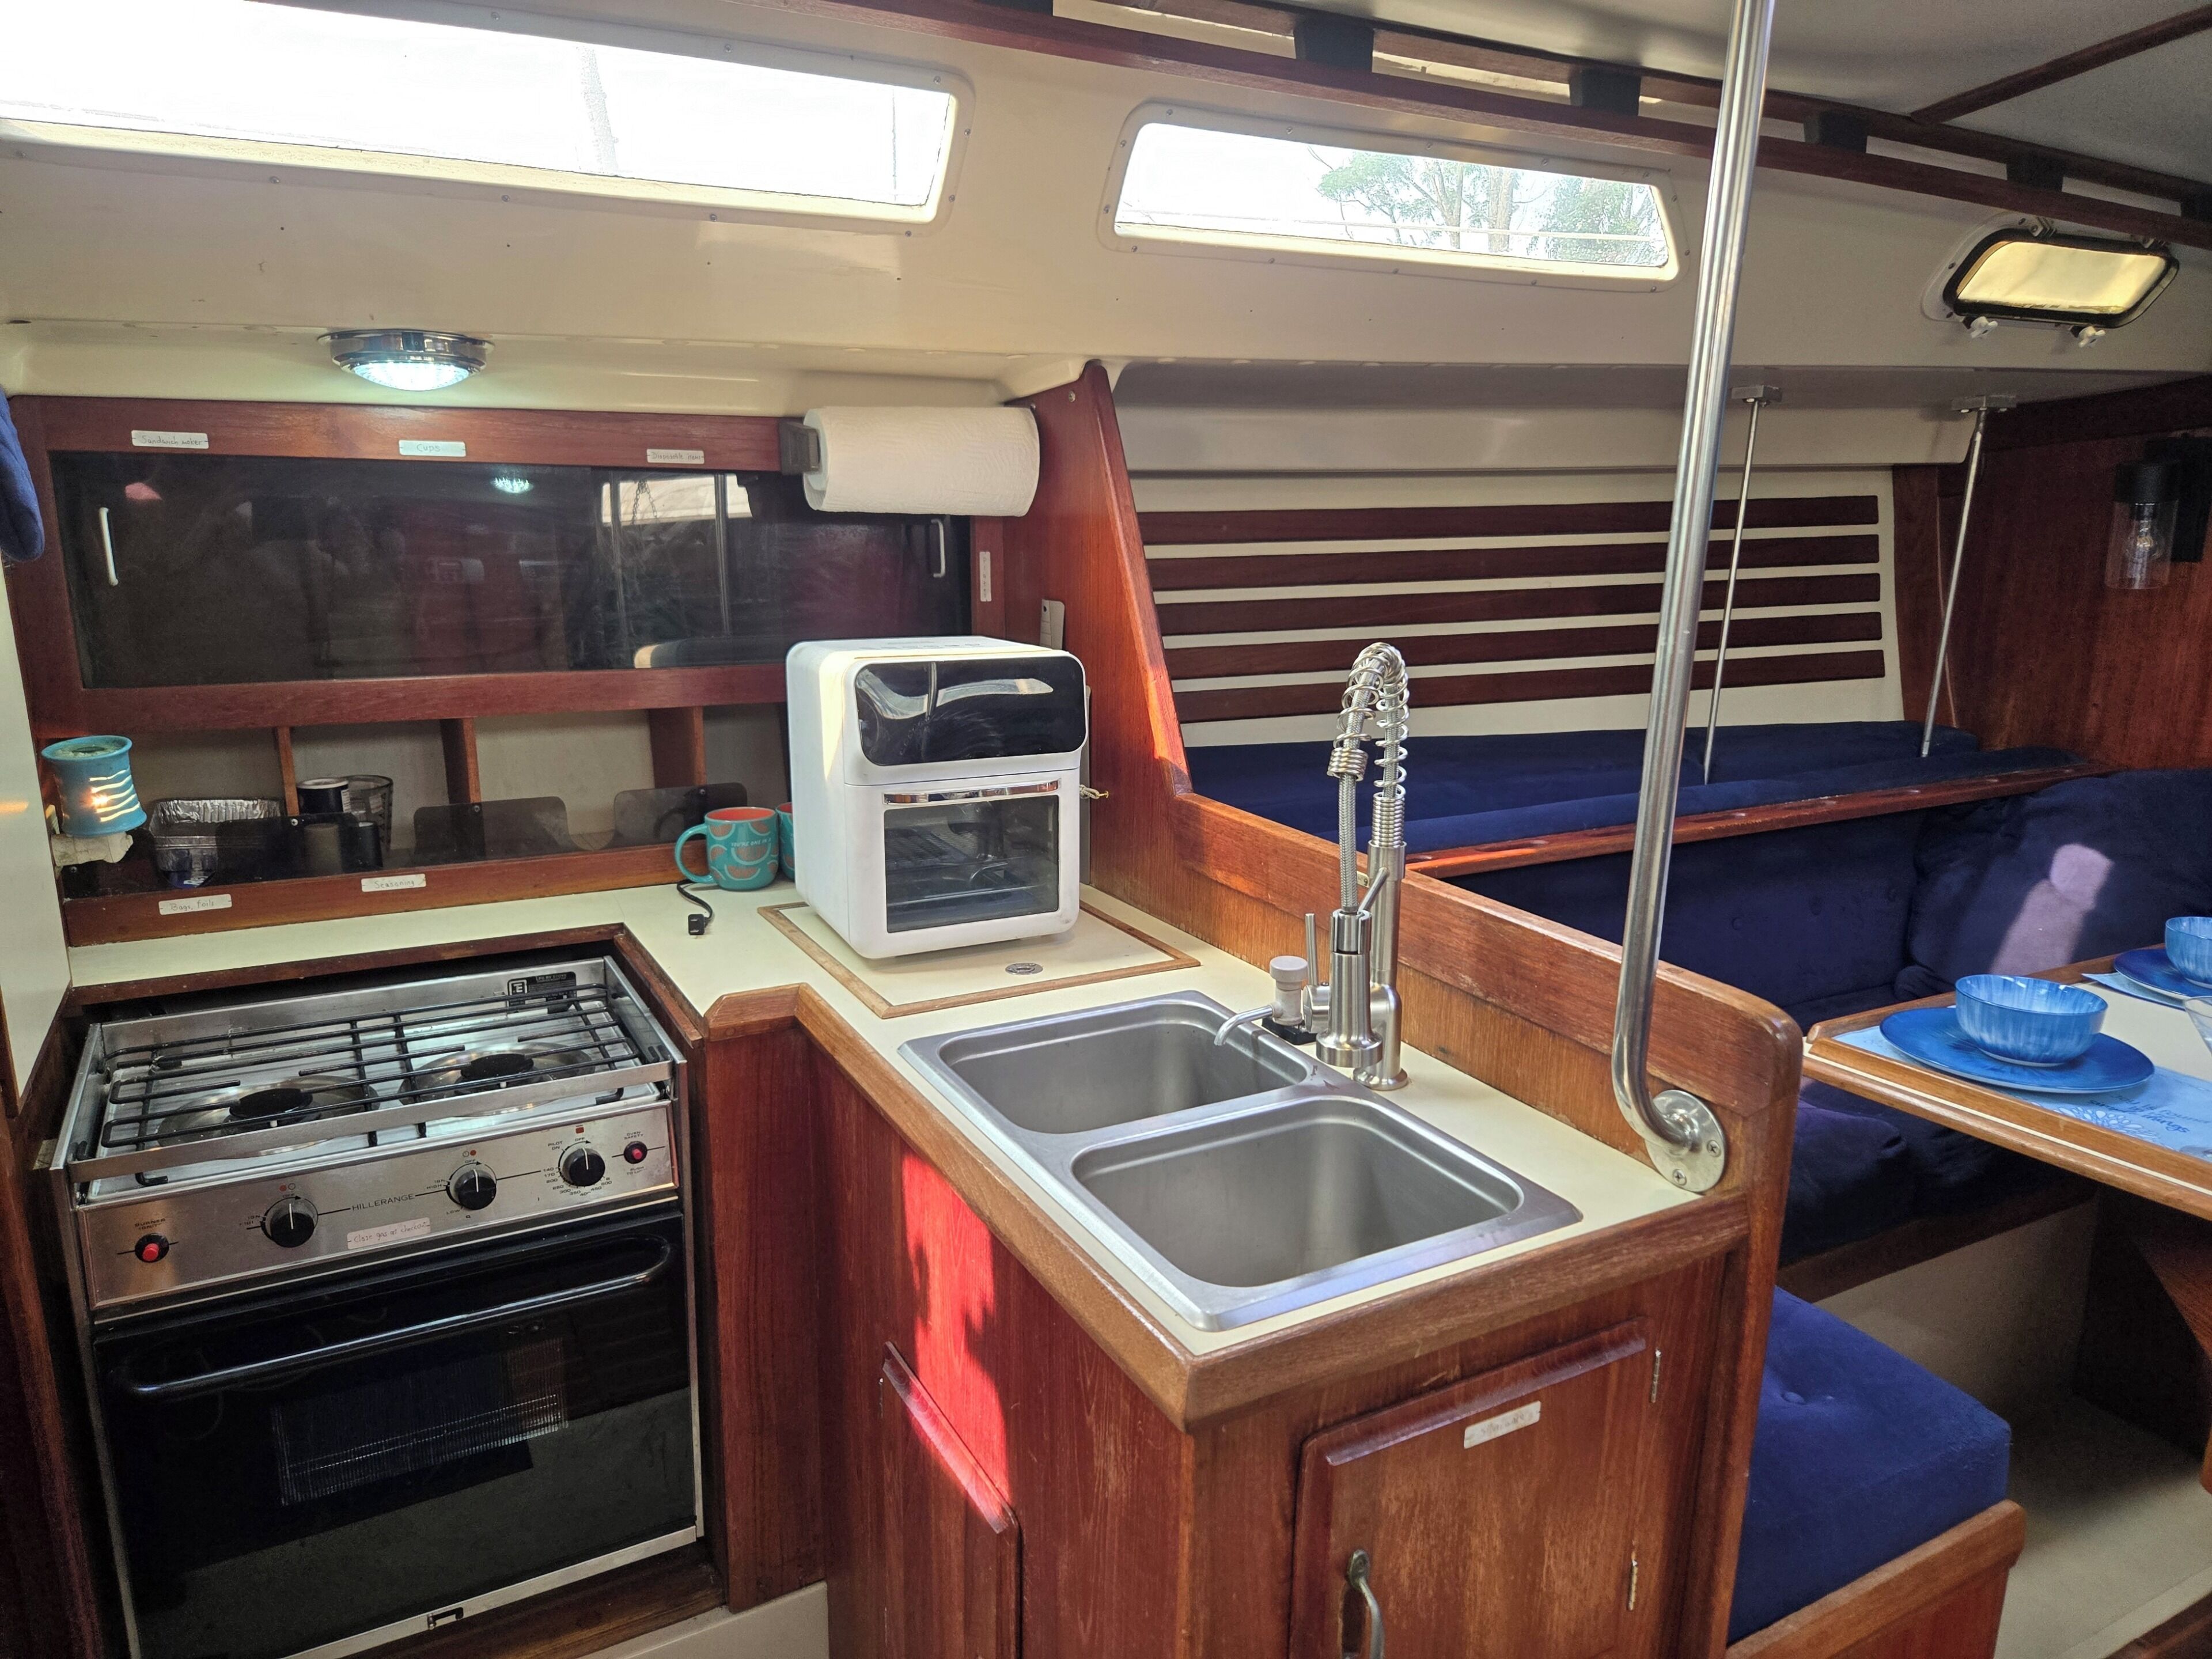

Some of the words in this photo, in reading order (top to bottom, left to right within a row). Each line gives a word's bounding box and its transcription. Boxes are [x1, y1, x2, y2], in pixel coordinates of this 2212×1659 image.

[416, 444, 441, 452] Cups
[374, 880, 415, 889] Seasoning
[352, 1193, 414, 1211] HILLERANGE
